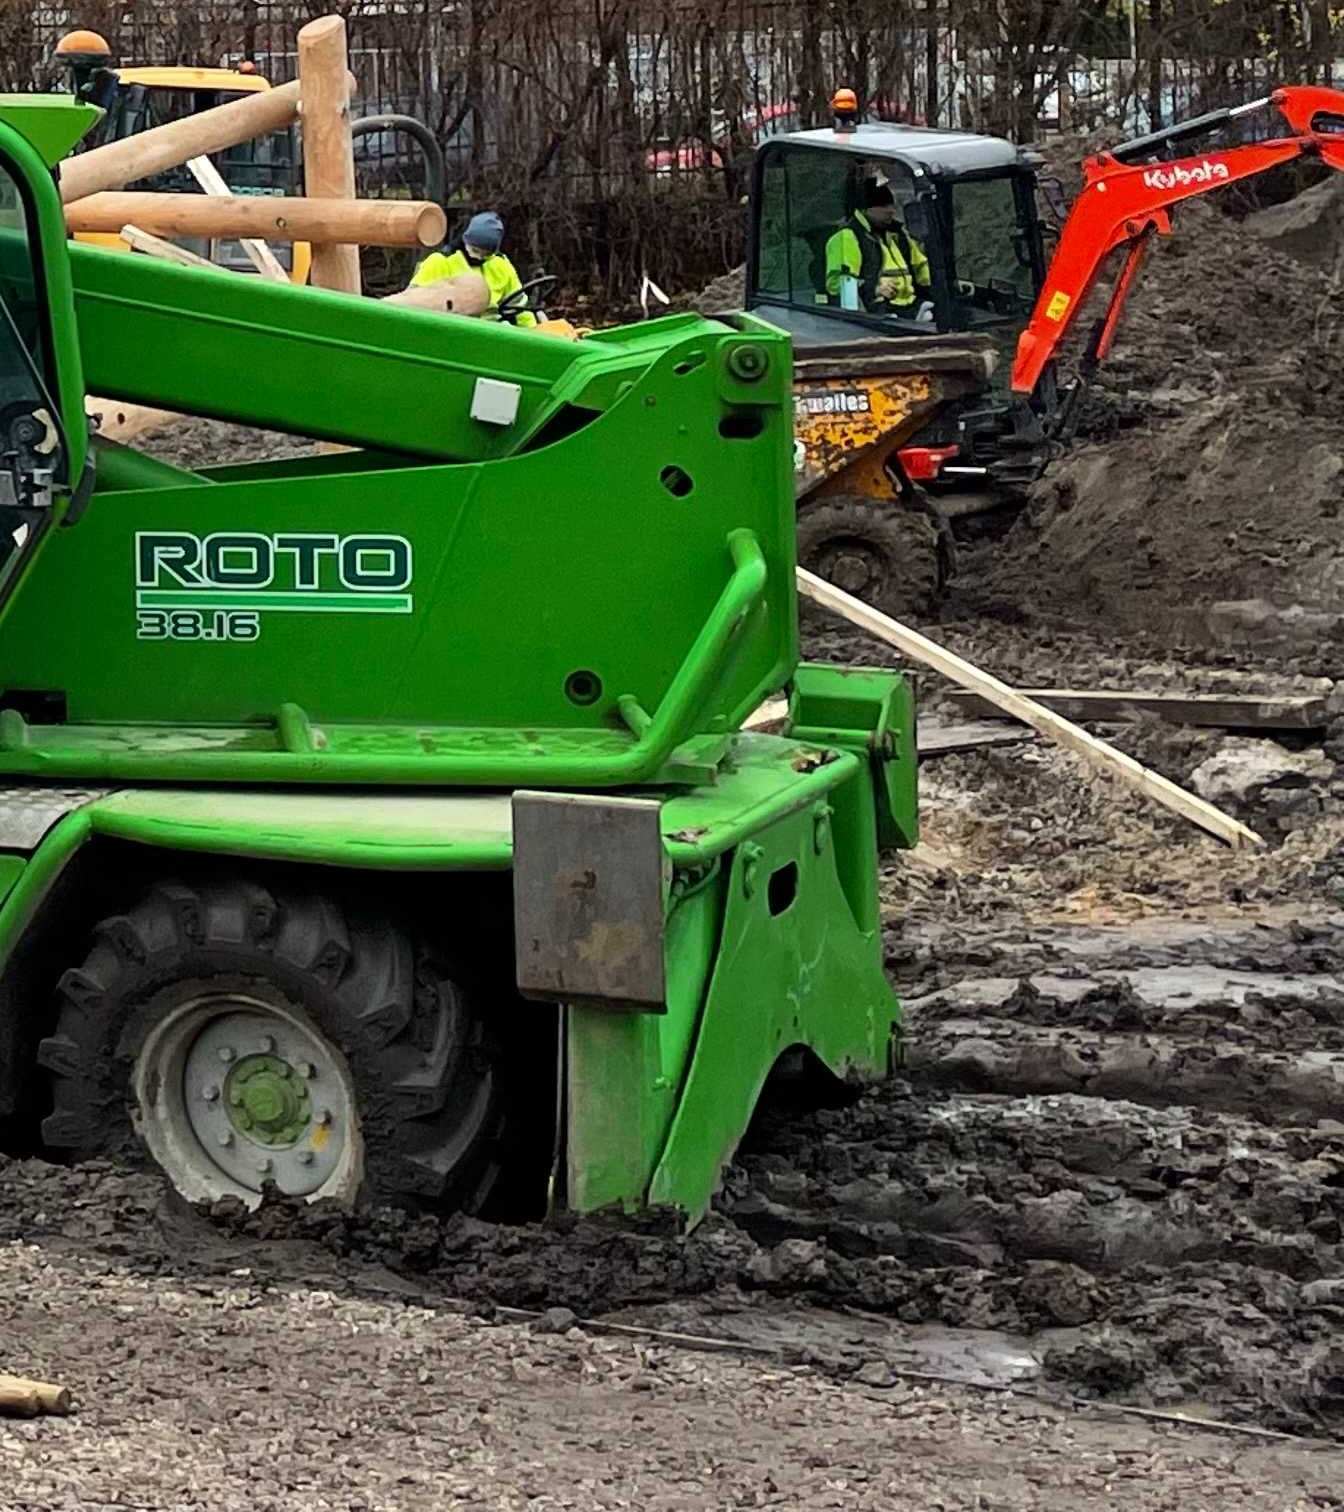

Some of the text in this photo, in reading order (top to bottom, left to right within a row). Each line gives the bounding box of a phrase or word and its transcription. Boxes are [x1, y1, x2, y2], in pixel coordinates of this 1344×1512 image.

[1144, 161, 1229, 189] Kubota
[135, 531, 412, 591] ROTO
[136, 610, 260, 641] 38.16
